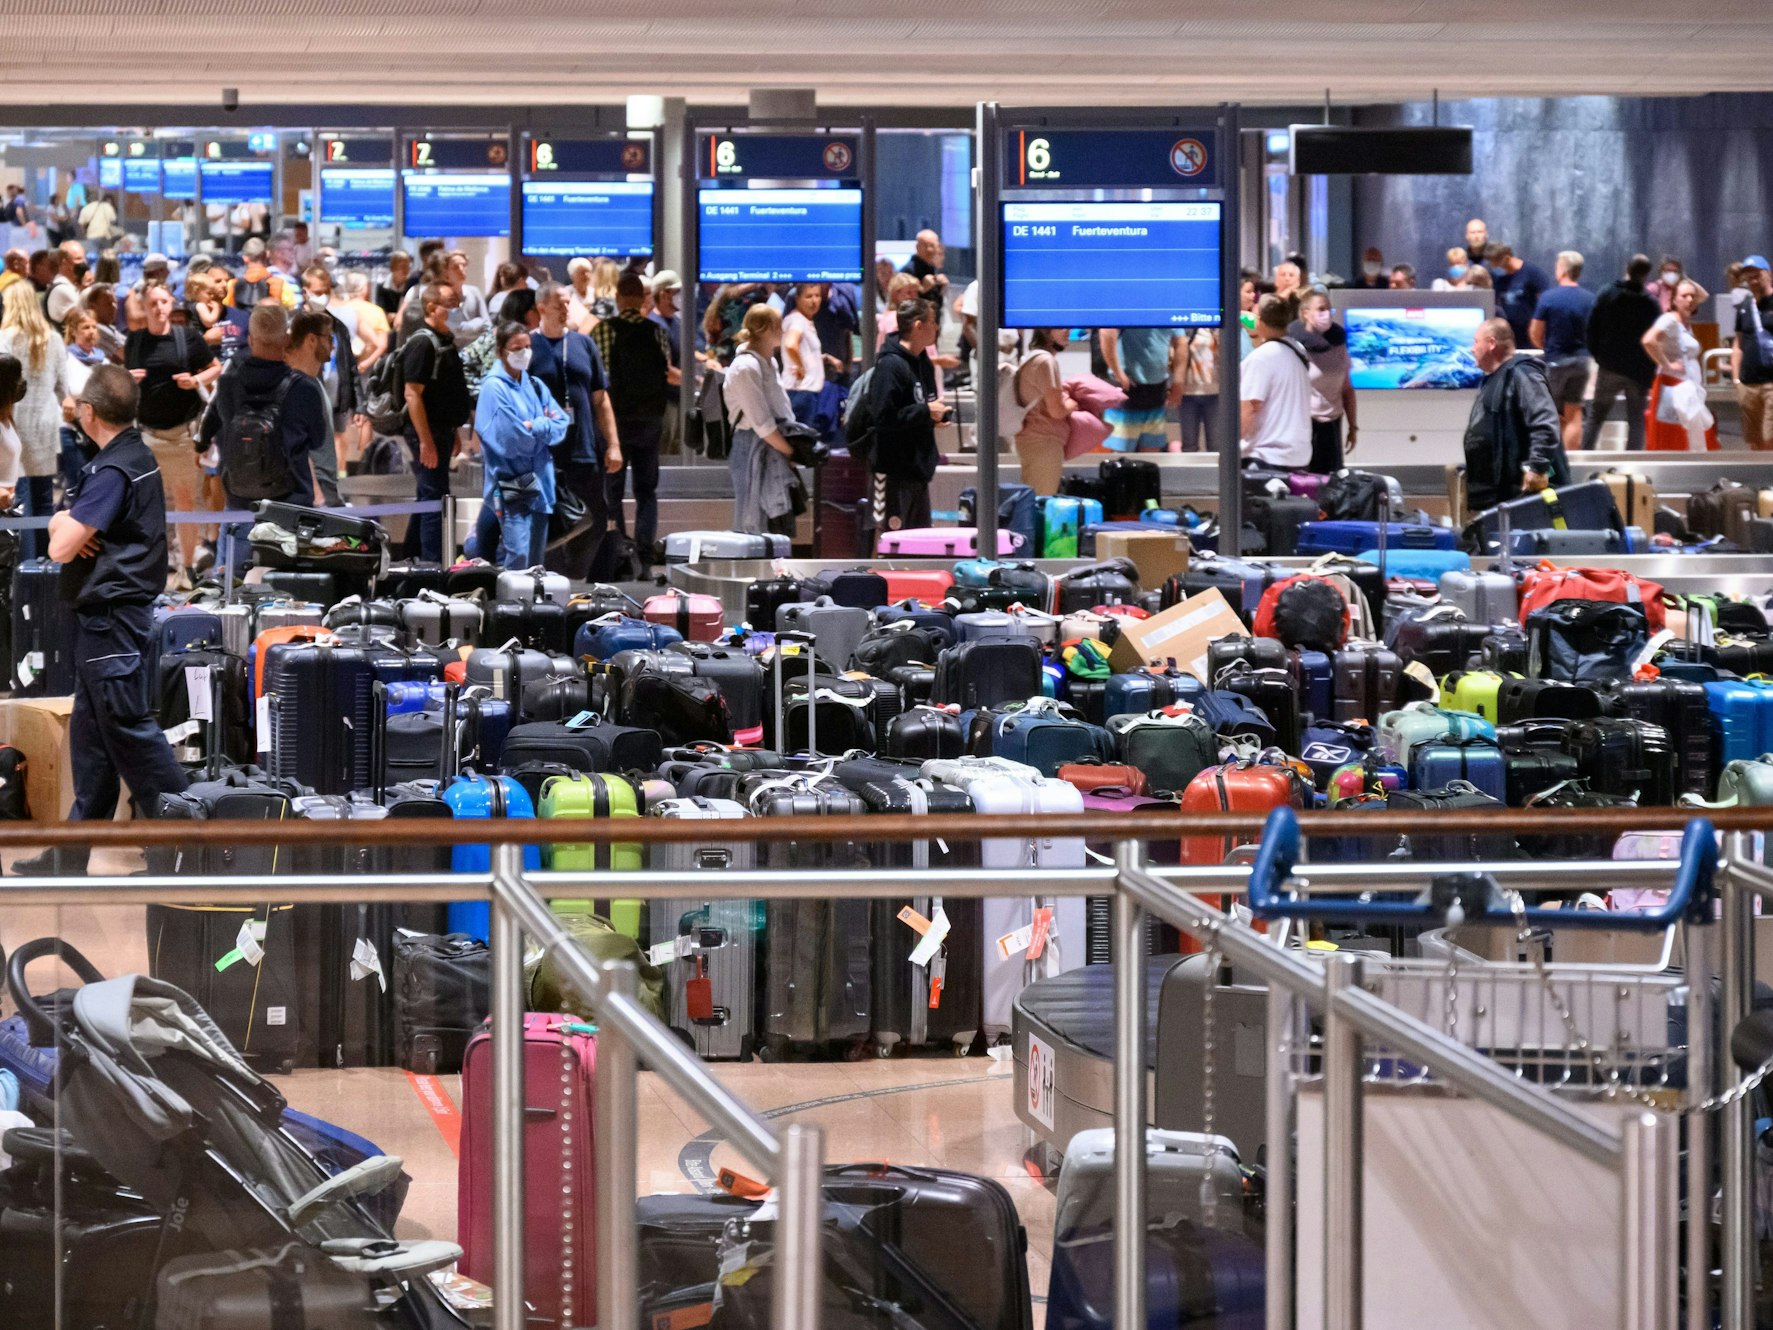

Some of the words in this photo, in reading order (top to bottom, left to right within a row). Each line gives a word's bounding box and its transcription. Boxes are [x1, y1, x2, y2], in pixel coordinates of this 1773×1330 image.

[536, 143, 553, 164] 6
[716, 141, 736, 166] 6
[1027, 138, 1051, 171] 6
[706, 206, 718, 215] DE
[719, 206, 740, 215] 1441
[750, 206, 808, 215] Fuerteventura
[1012, 225, 1029, 237] DE
[1031, 225, 1057, 237] 1441
[1072, 225, 1149, 237] Fuerteventura
[706, 271, 739, 281] Ausgang
[739, 271, 770, 279] Terminal
[1190, 312, 1212, 322] Bitte
[168, 1196, 189, 1233] Joie
